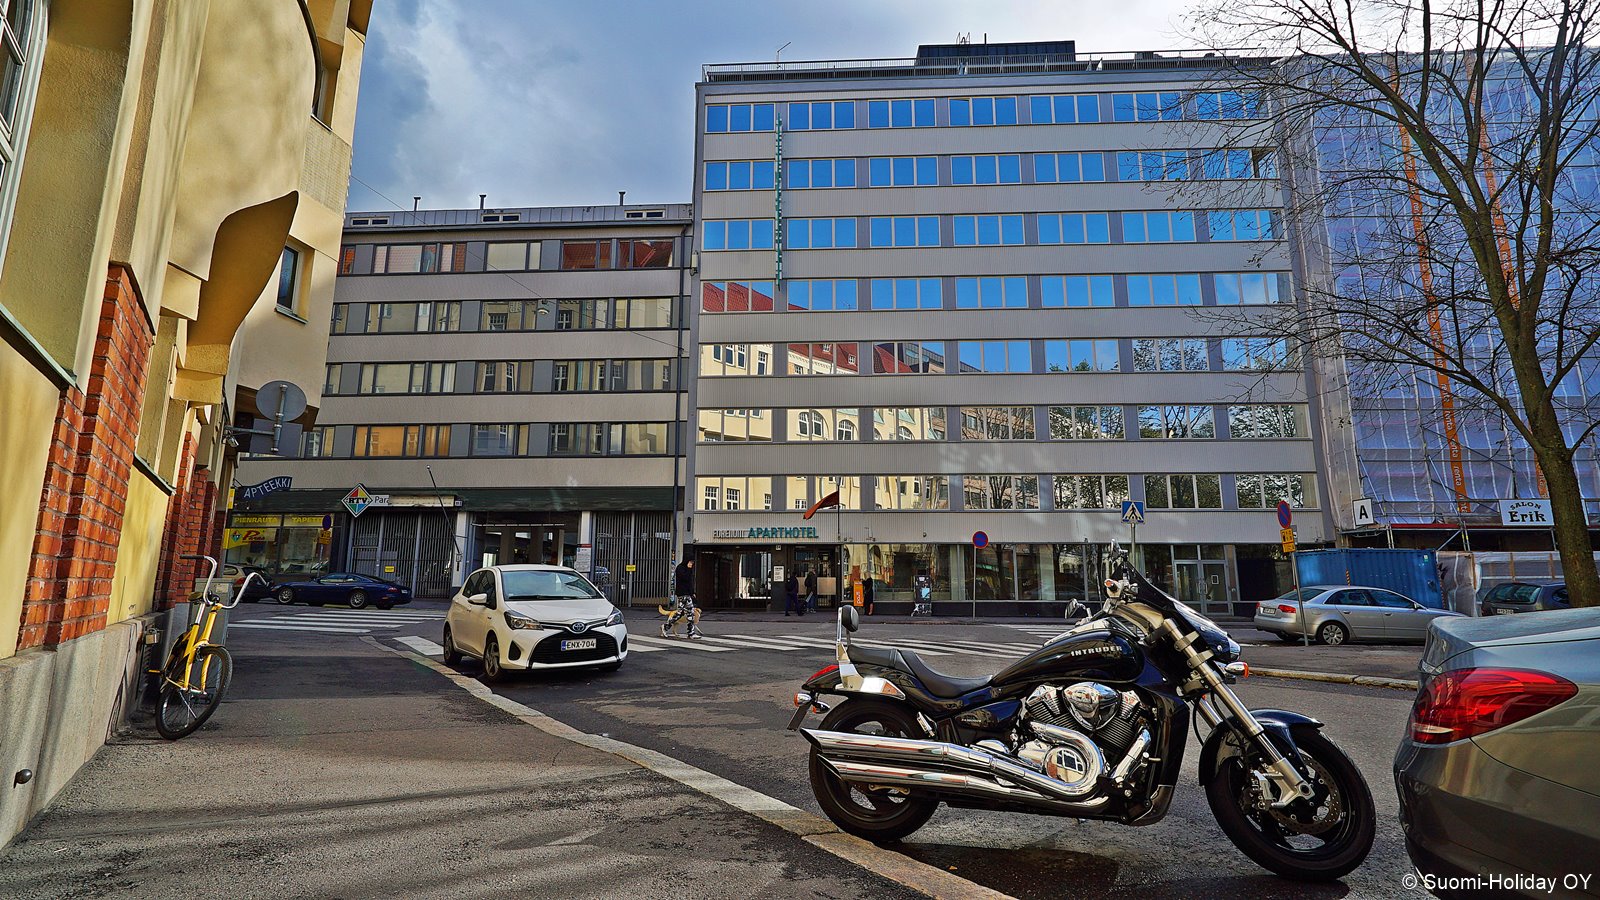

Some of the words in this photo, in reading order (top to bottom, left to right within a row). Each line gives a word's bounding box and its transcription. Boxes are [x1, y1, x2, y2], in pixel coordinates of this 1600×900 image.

[1444, 410, 1453, 431] renta
[1453, 465, 1462, 486] renta
[243, 478, 291, 498] APTEEKKI
[1510, 501, 1542, 510] SALON
[1359, 505, 1369, 520] A
[1508, 510, 1547, 523] Erik
[748, 527, 819, 538] APARTHOTEL
[567, 640, 595, 649] ENX-704
[1070, 645, 1123, 657] INTRUDER
